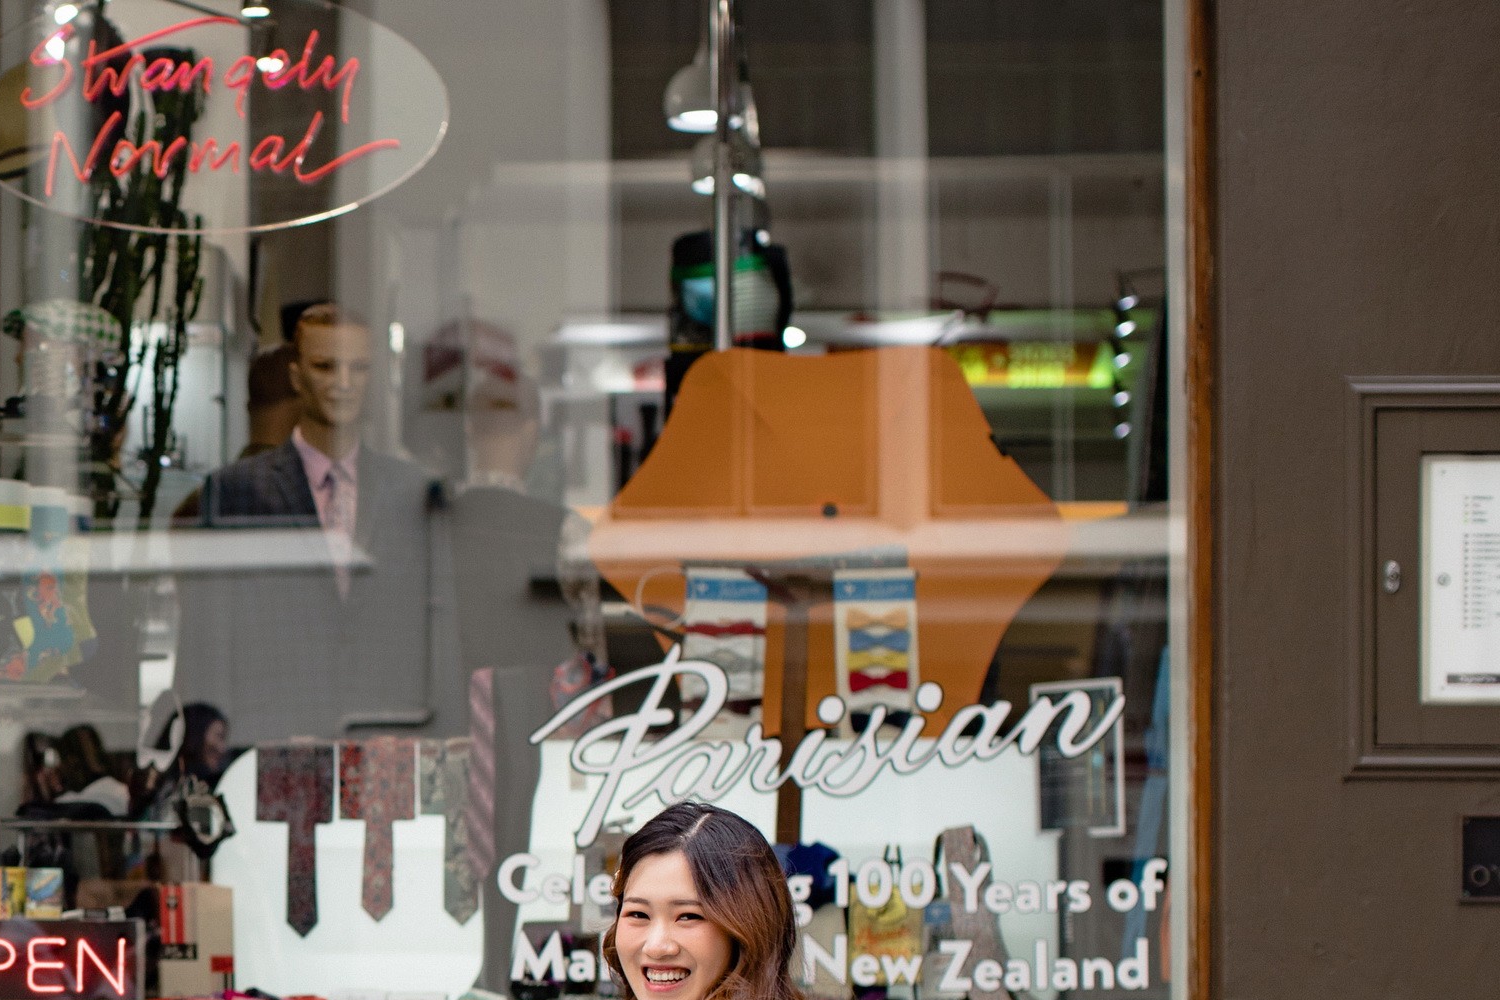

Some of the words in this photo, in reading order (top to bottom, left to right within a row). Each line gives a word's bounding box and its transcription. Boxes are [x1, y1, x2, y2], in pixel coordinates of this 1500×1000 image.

[19, 16, 361, 123] Strangely
[44, 110, 401, 196] Normal
[529, 642, 1127, 848] Parisian
[827, 857, 937, 910] 100
[949, 861, 1093, 915] Years
[1106, 857, 1169, 912] of
[802, 932, 924, 988] New
[938, 937, 1150, 992] Zealand
